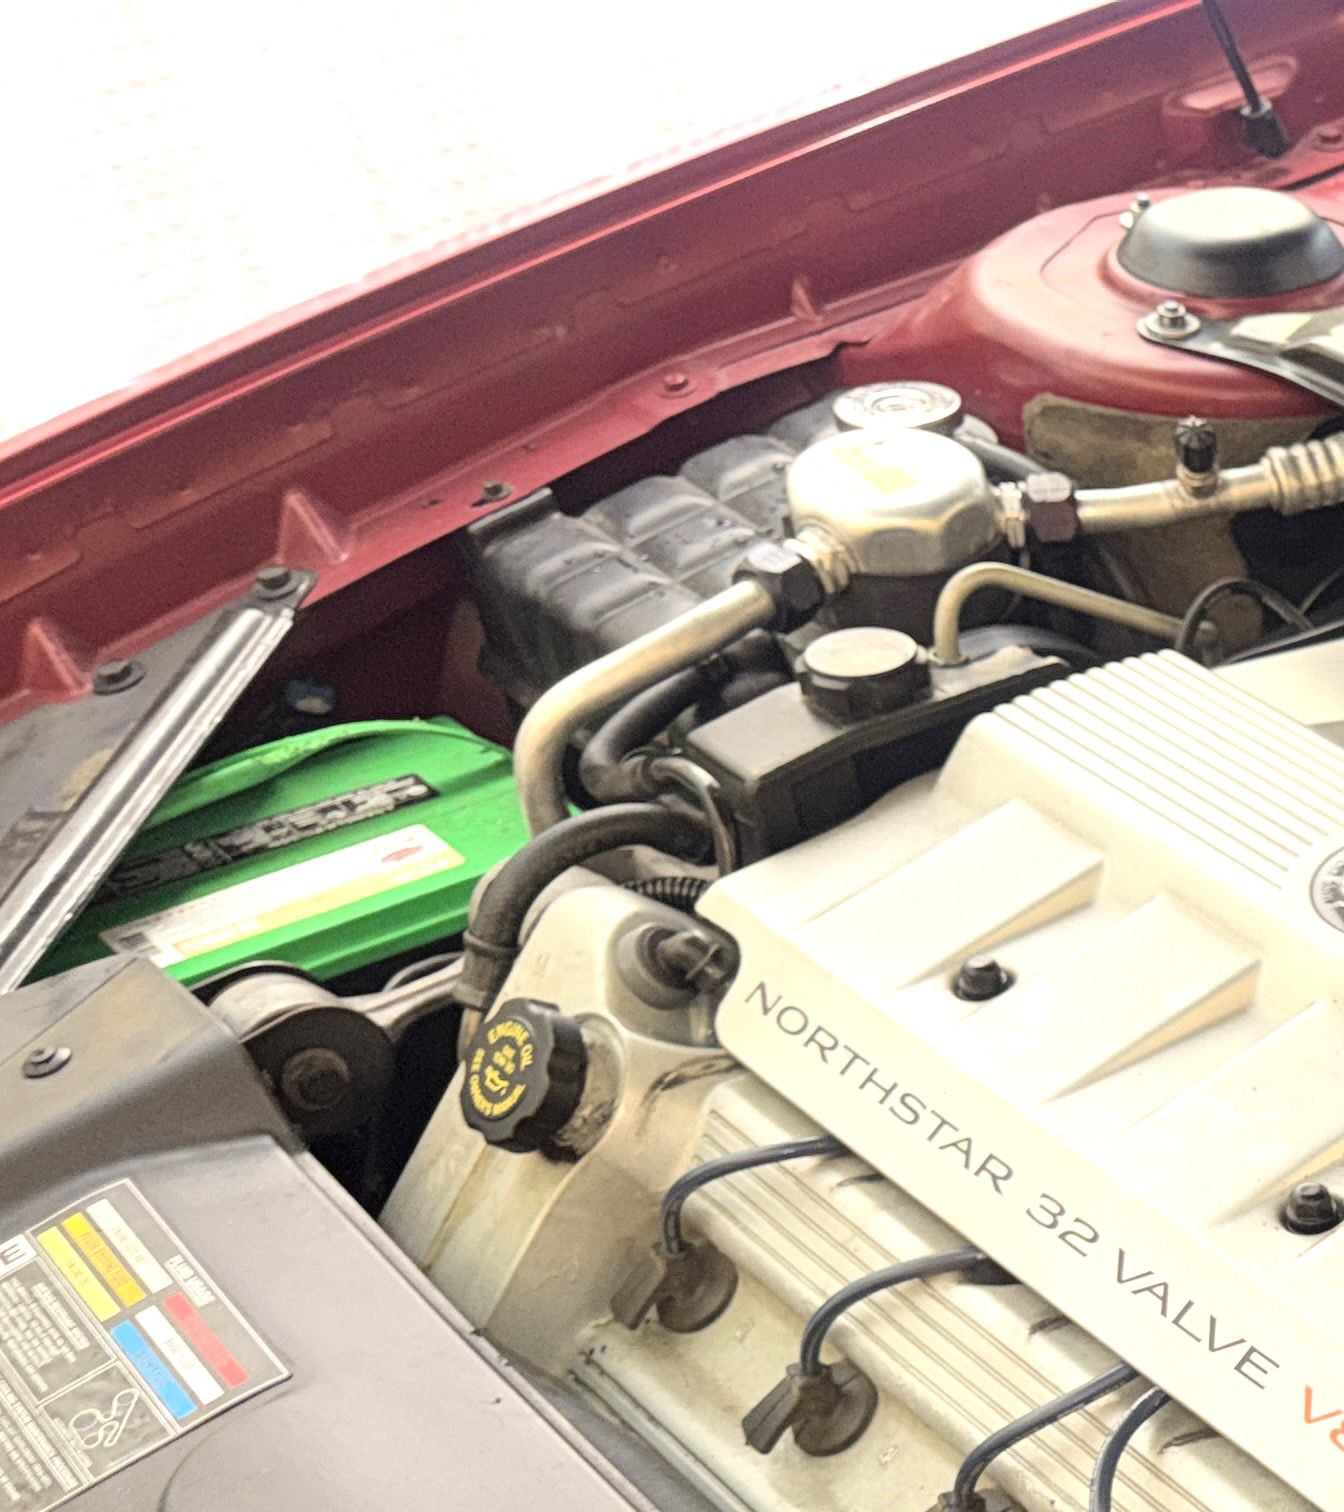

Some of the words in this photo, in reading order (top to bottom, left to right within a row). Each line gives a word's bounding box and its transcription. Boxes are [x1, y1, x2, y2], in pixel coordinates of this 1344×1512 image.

[745, 982, 1012, 1194] NORTHSTAR
[1027, 1194, 1099, 1256] 32
[1117, 1249, 1279, 1389] VALVE
